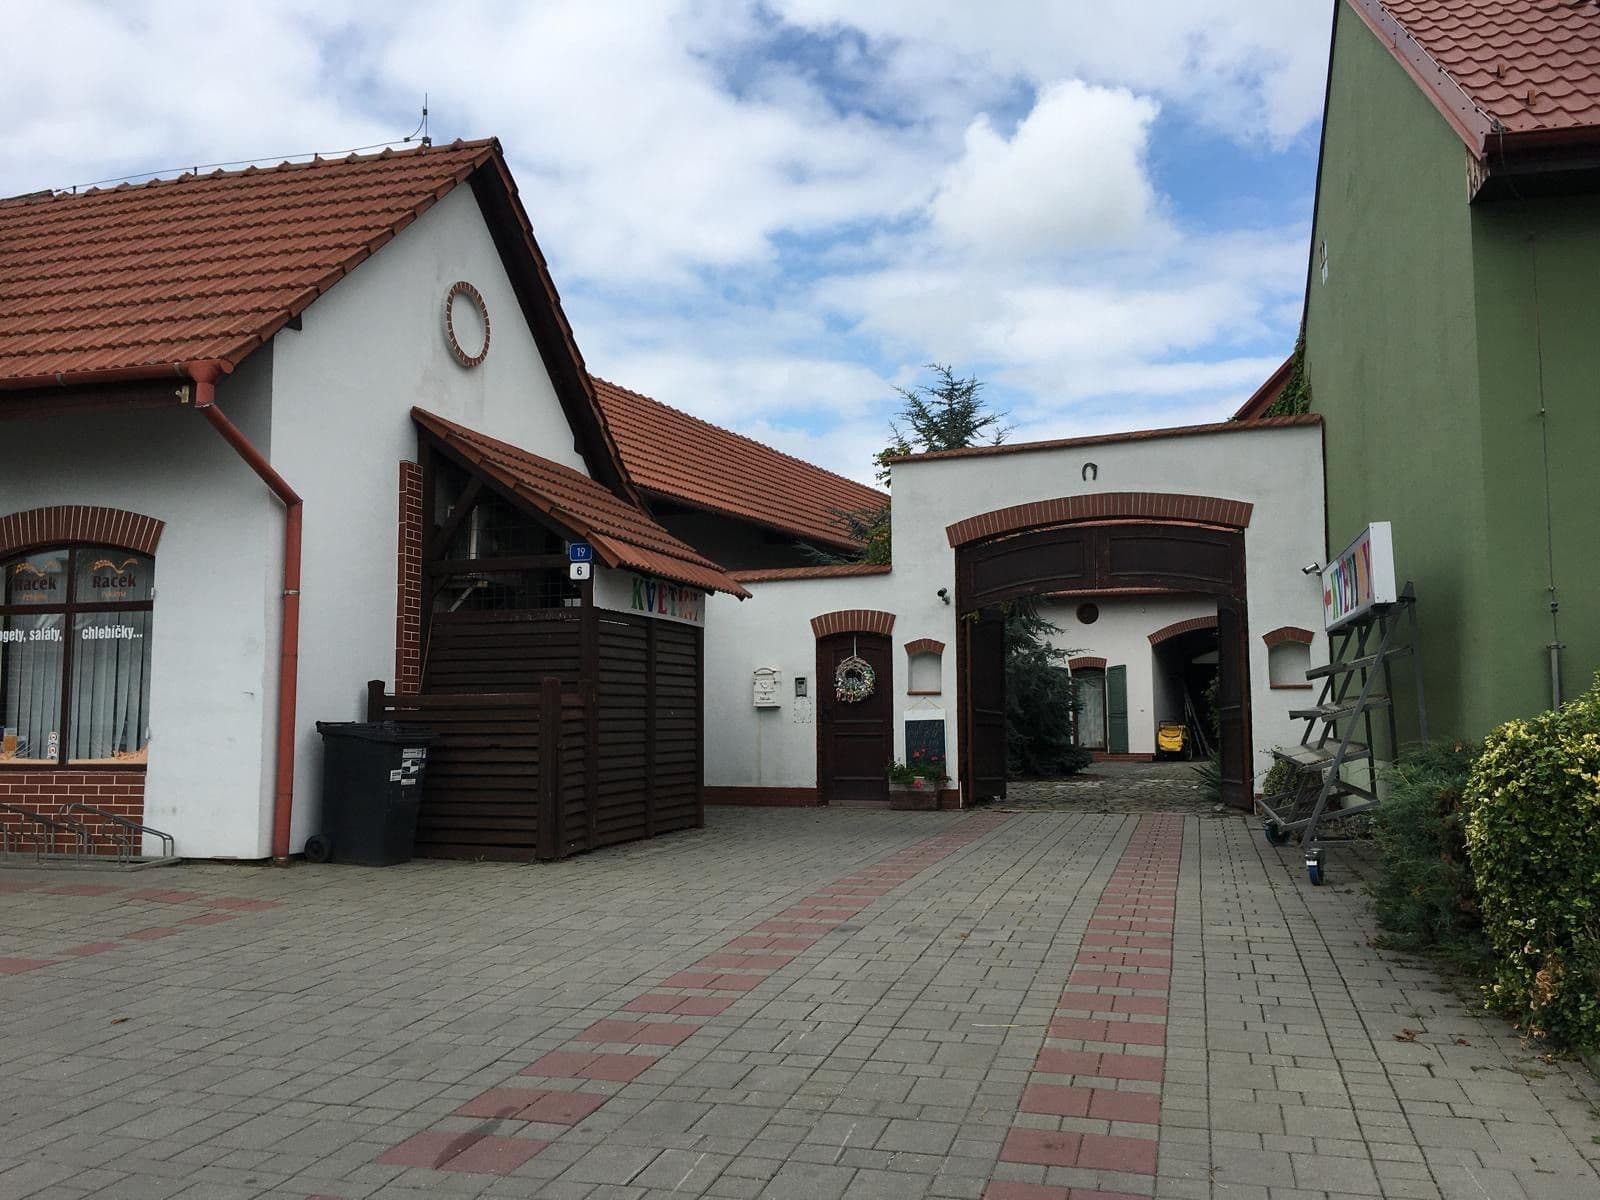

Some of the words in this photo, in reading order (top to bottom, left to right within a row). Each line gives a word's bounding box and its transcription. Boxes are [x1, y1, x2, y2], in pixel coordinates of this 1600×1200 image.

[576, 547, 586, 557] 19
[576, 566, 583, 576] 6
[92, 574, 137, 588] Racek
